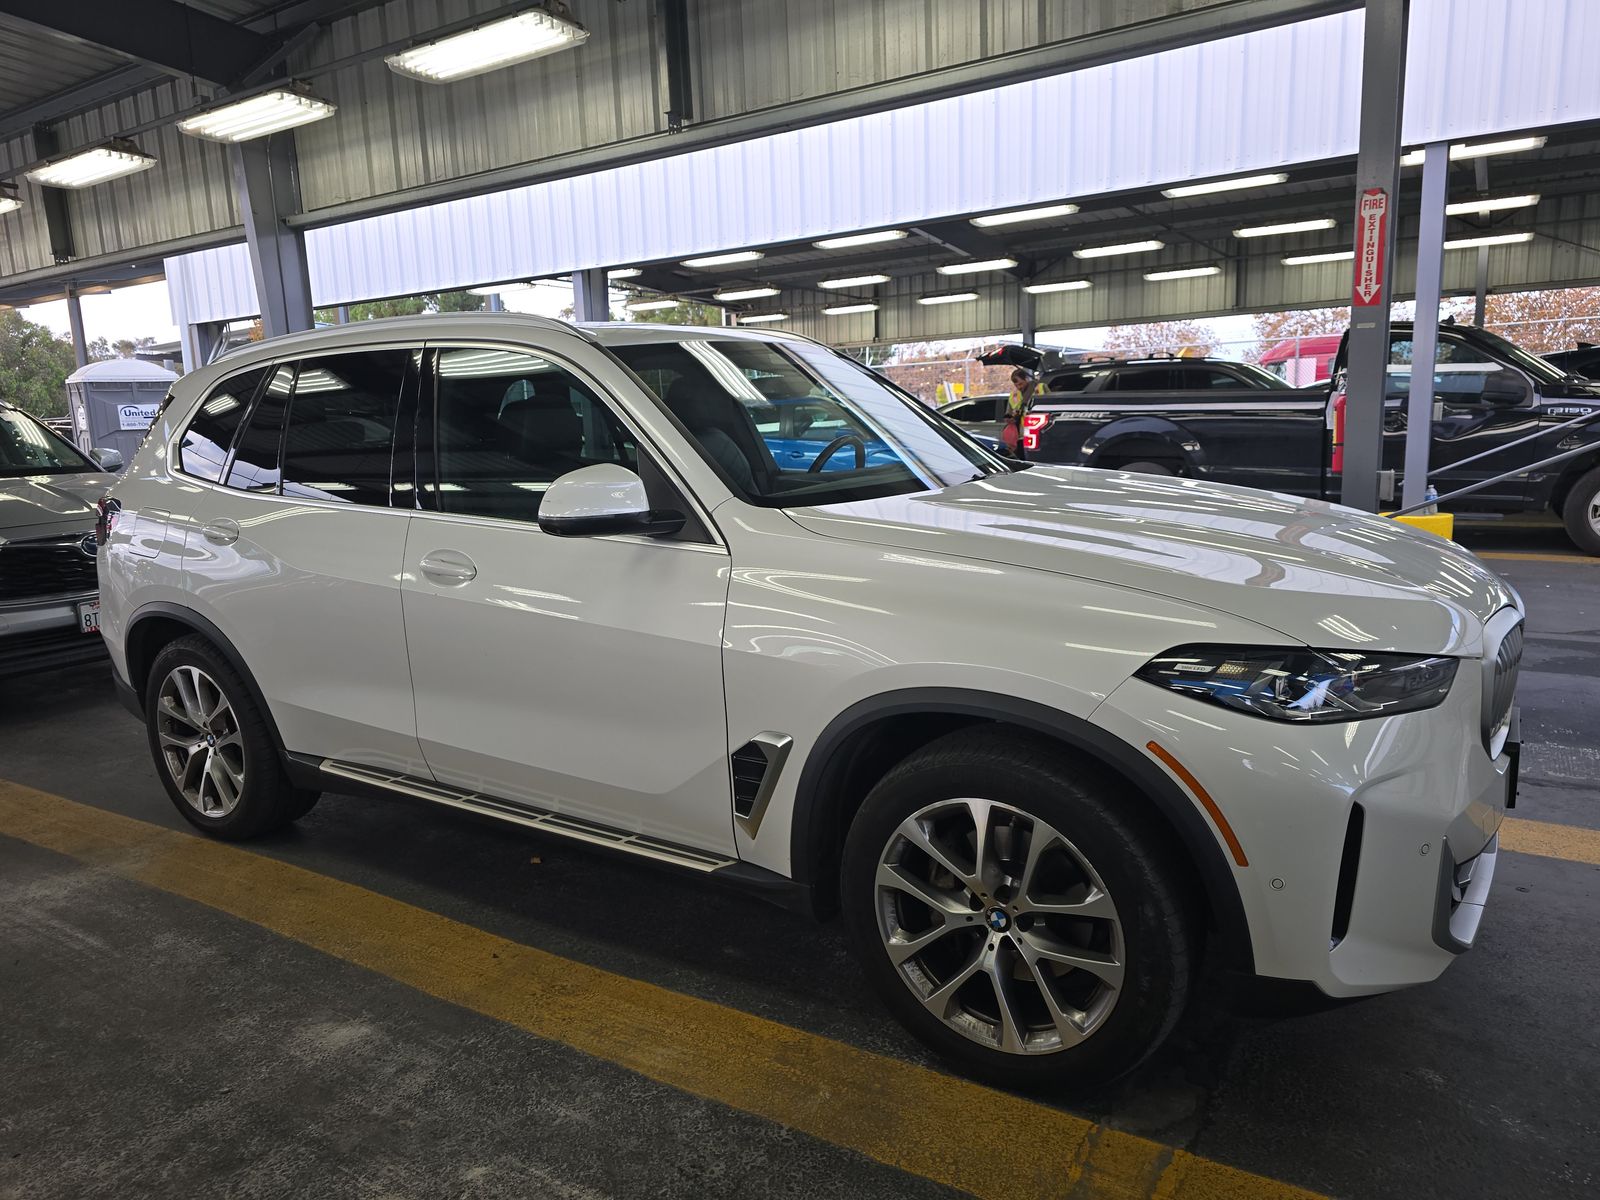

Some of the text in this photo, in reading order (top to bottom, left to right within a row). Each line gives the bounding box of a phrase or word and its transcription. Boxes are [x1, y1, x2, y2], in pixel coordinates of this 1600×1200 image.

[1364, 198, 1384, 210] FIRE
[1364, 214, 1377, 297] EXTINGUISHER
[124, 409, 156, 417] United
